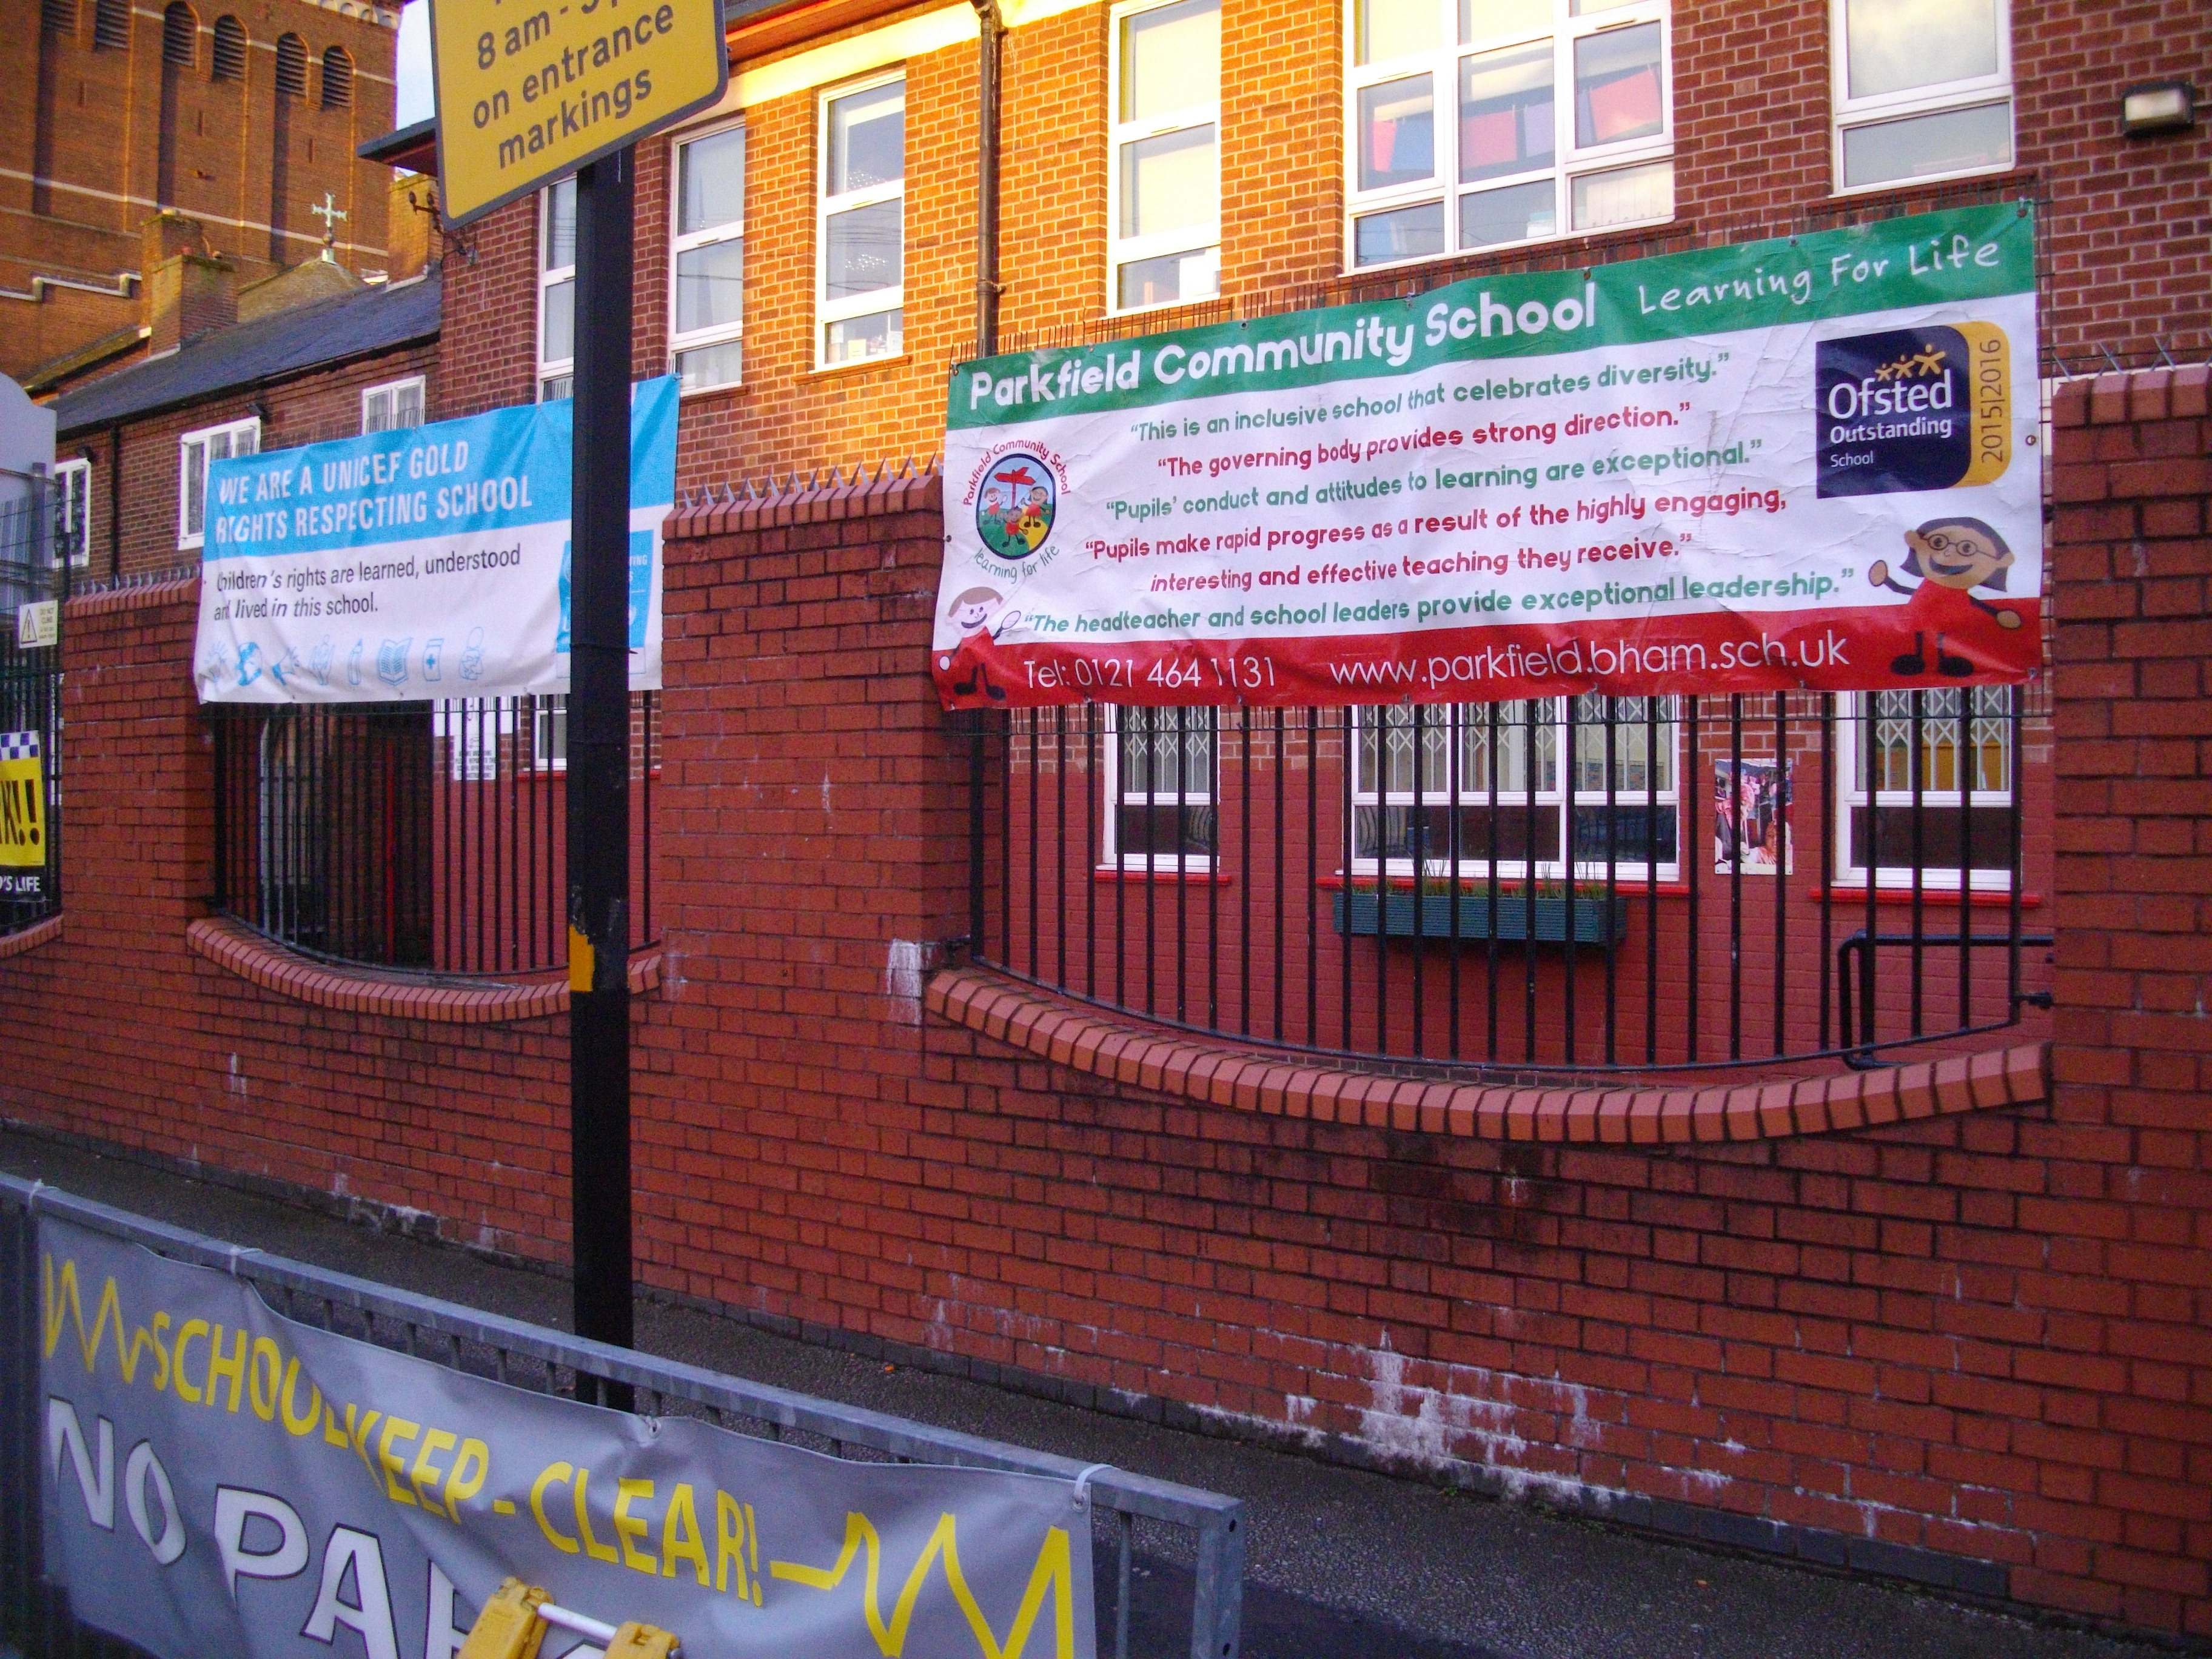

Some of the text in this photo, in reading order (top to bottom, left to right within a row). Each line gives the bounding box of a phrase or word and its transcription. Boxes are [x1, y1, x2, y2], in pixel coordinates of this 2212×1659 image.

[474, 4, 674, 128] on entrance
[500, 69, 652, 169] markings
[1639, 234, 2000, 314] Learning For Life
[970, 281, 1596, 409] Parkfield Community School
[1130, 352, 1729, 441] “This is an inclusive school that celebrates diversity.”
[1828, 369, 1952, 420] Ofsted
[1158, 401, 1691, 477] “The governing body provides strong direction.”
[1830, 417, 1952, 444] Outstanding
[1830, 450, 1874, 468] School
[219, 440, 469, 504] WE ARE A UNICEF GOLD
[963, 440, 1071, 506] Parkfield Community School
[1183, 486, 1258, 517] conduct
[1266, 484, 1308, 505] and
[1315, 480, 1402, 504] attitudes
[1408, 472, 1427, 491] to
[1435, 465, 1537, 490] learning
[1545, 462, 1584, 481] are
[1592, 438, 1762, 475] exceptional.”
[216, 475, 532, 543] RIGHTS RESPECTING SCHOOL
[1086, 488, 1786, 562] “Pupils make rapid progress as a result of the highly engaging,
[287, 566, 327, 592] rights
[330, 568, 355, 584] are
[359, 557, 420, 581] learned,
[424, 543, 521, 577] understood
[973, 545, 1060, 584] learning for life
[1150, 532, 1692, 593] interesting and effective teaching they receive.”
[235, 598, 268, 618] lived
[271, 598, 287, 617] in
[293, 597, 321, 617] this
[326, 591, 378, 615] school.
[1074, 608, 1201, 632] headteacher
[1208, 606, 1244, 627] and
[1250, 602, 1326, 625] school
[1333, 599, 1410, 623] leaders
[1417, 589, 1512, 623] provide
[1521, 577, 1675, 612] exceptional
[1683, 568, 1854, 600] leadership.”
[1147, 657, 1202, 688] 464
[1210, 657, 1275, 688] 1131
[1330, 630, 1851, 691] www.parkfield.bham.sch.uk
[16, 876, 41, 893] LIFE
[49, 1395, 187, 1566] NO
[150, 1310, 349, 1449] SCHOOL
[348, 1404, 489, 1524] KEEP
[530, 1461, 763, 1607] CLEAR!
